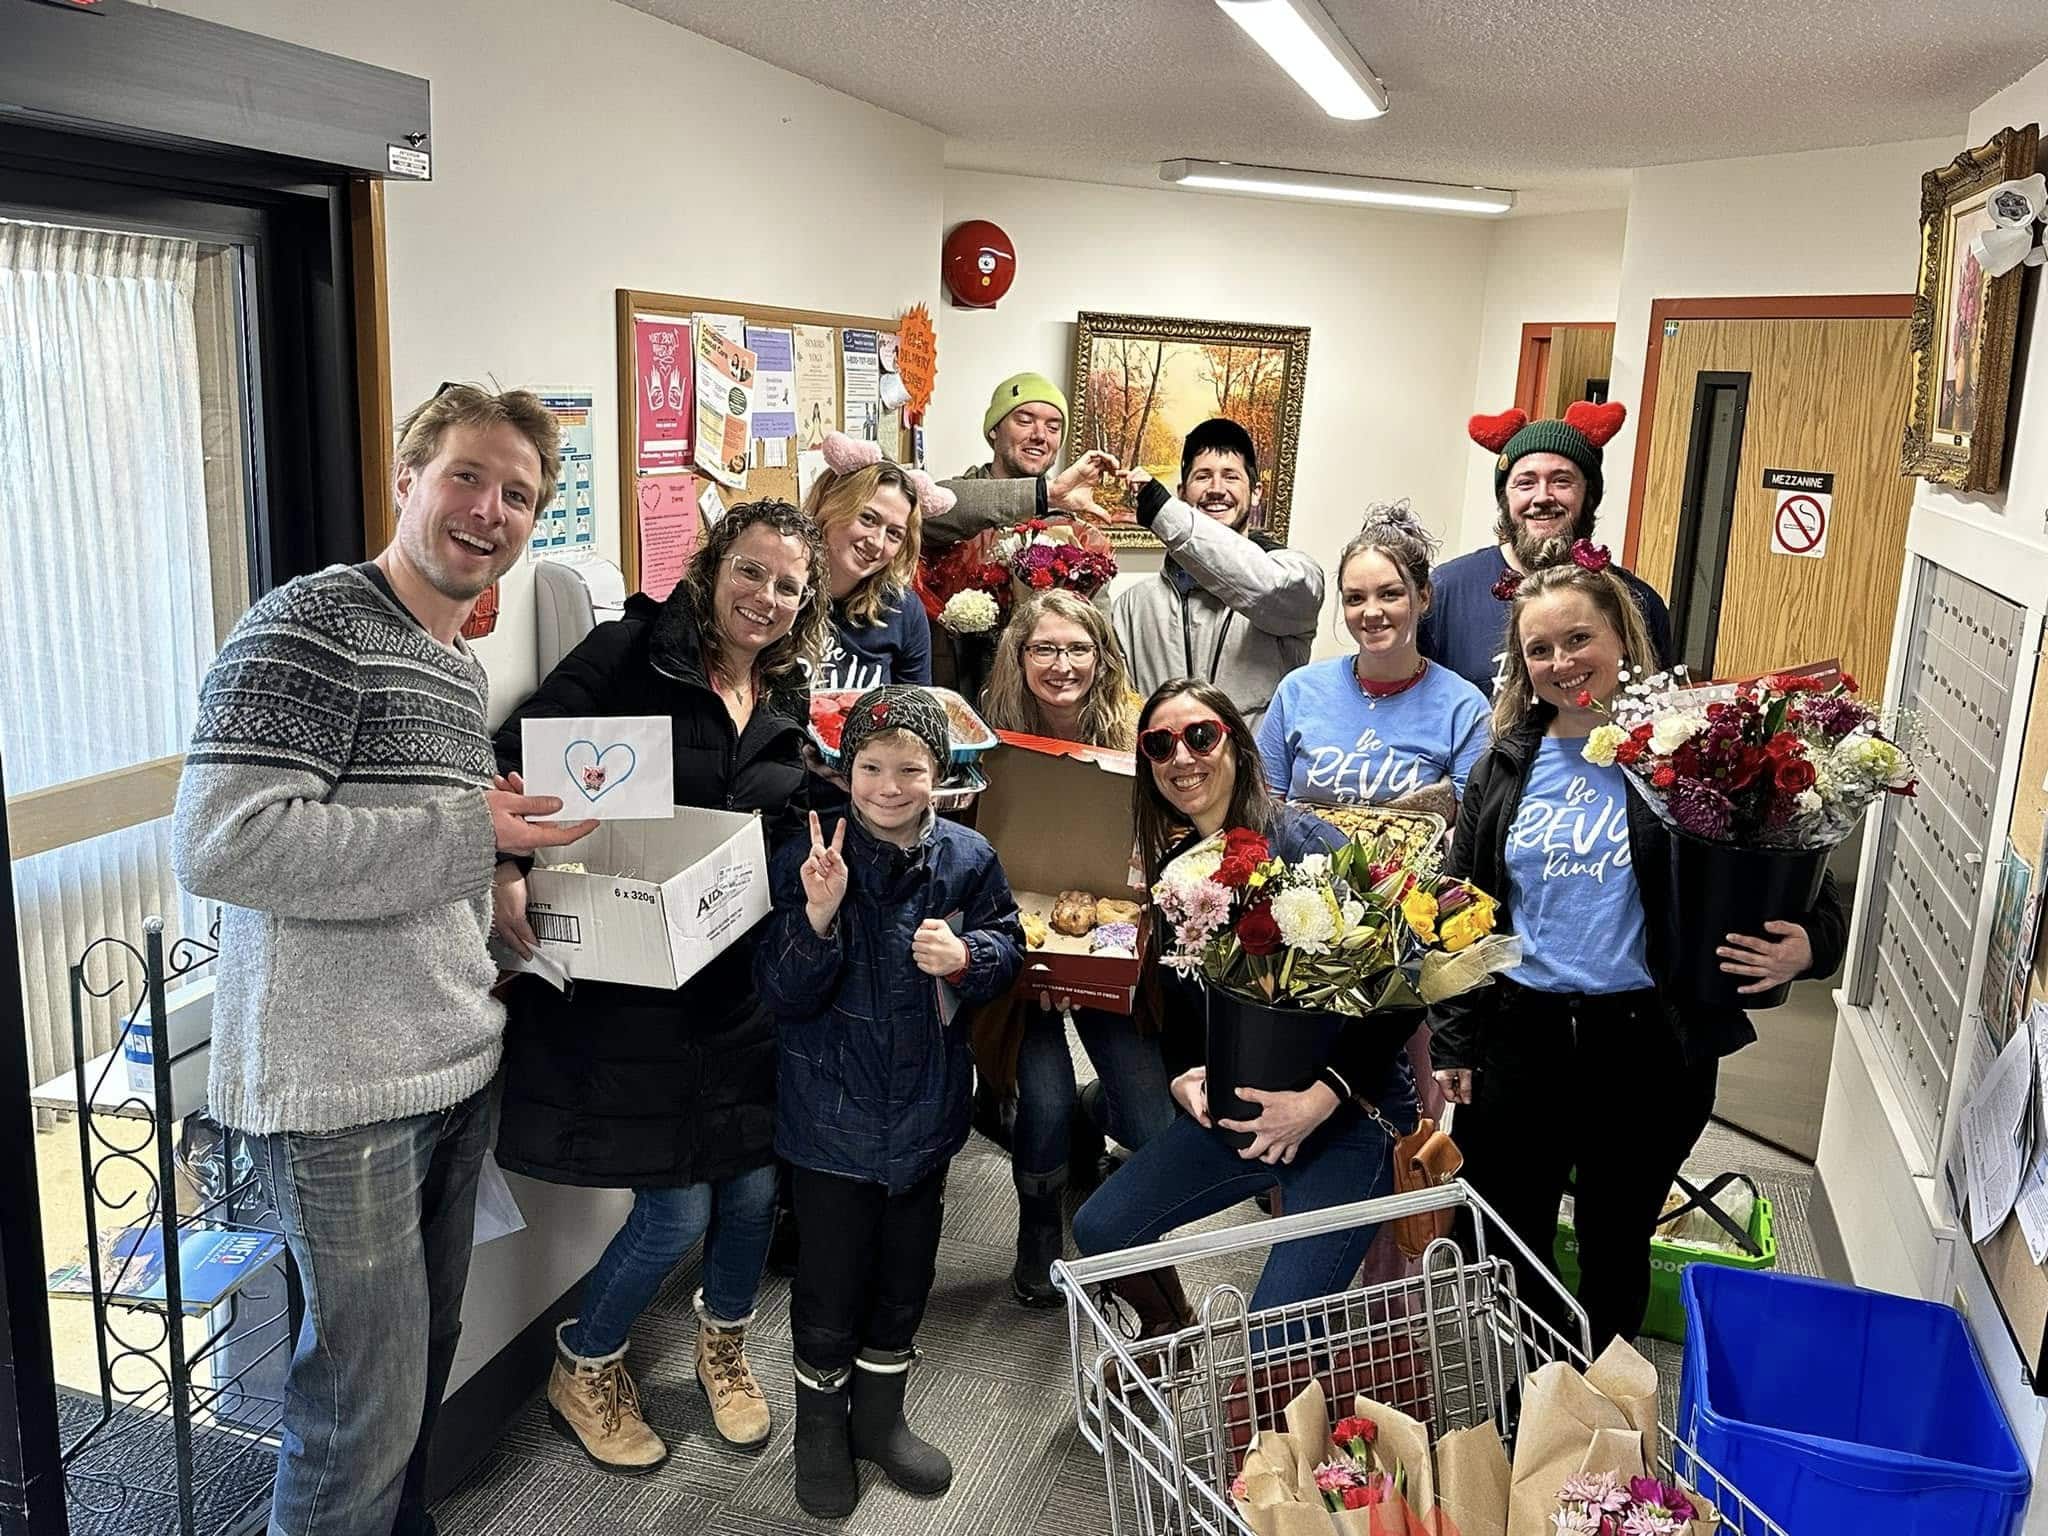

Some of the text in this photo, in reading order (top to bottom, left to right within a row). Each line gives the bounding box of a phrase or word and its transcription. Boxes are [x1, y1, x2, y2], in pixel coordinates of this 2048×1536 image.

[1771, 473, 1824, 488] MEZZANINE
[1356, 728, 1384, 751] Be
[1565, 776, 1600, 806] Be
[1543, 851, 1611, 883] Kind
[614, 888, 655, 904] 6 x 320g
